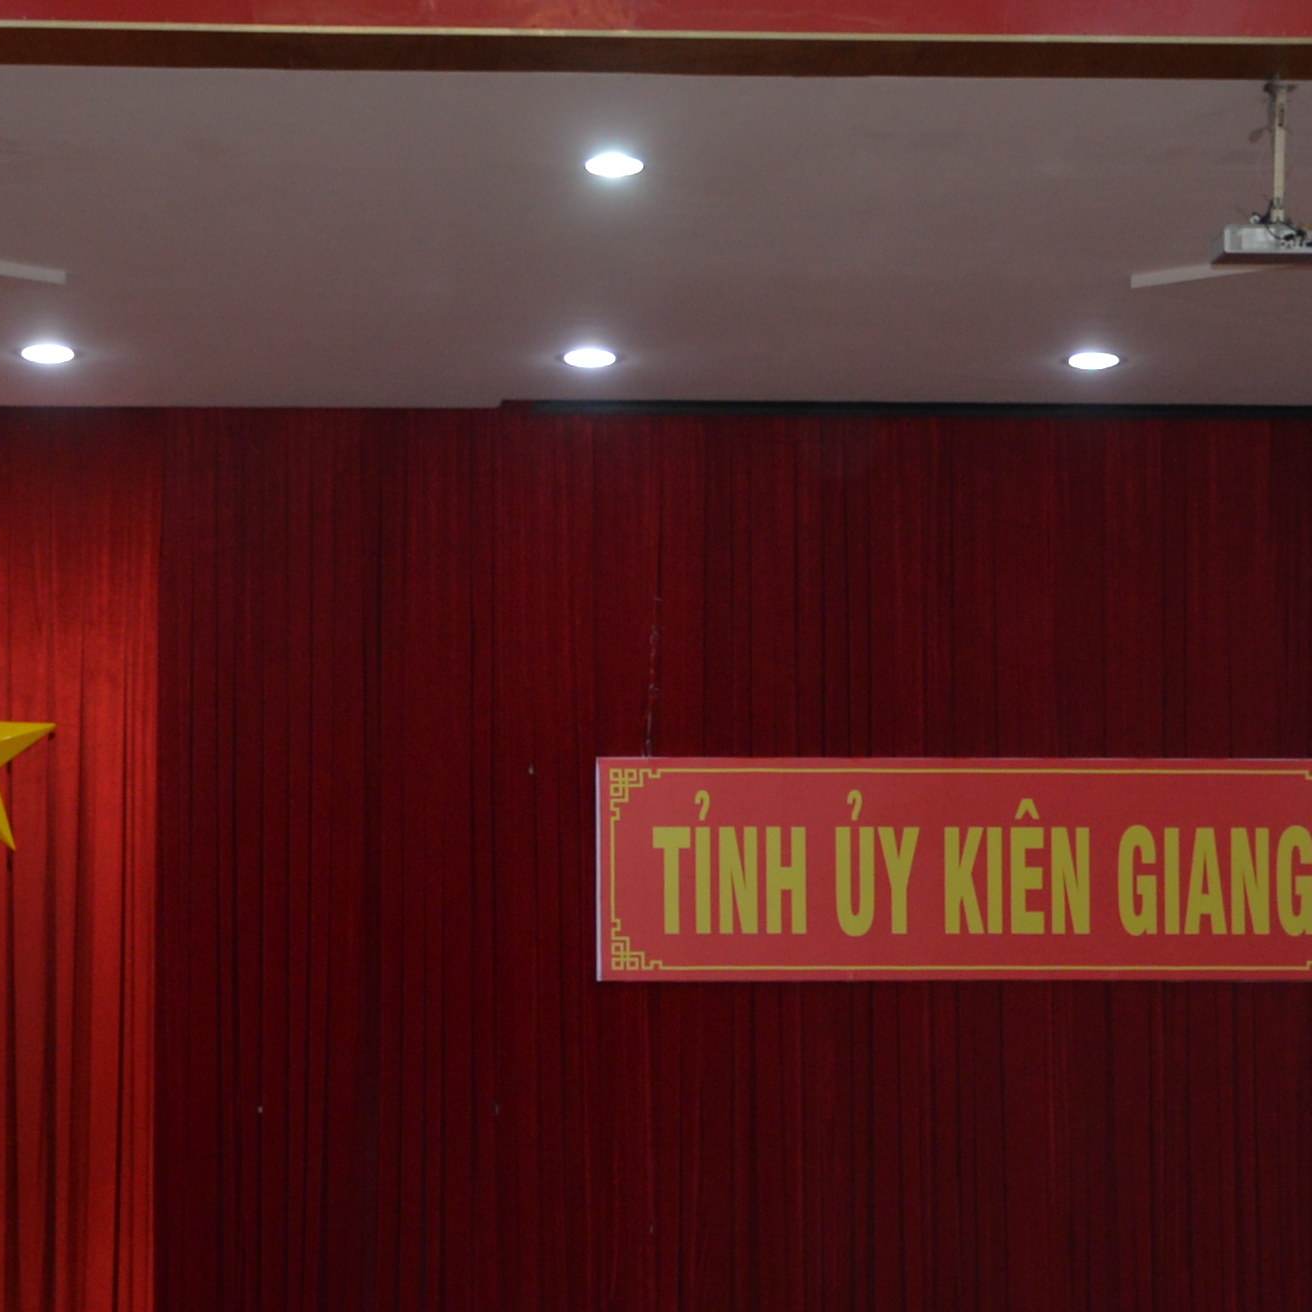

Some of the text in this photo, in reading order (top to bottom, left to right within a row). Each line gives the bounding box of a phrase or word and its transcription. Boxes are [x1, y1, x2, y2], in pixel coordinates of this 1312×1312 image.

[653, 790, 807, 934] TỈNH
[834, 790, 920, 936] ỦY
[944, 798, 1090, 935] KIÊN
